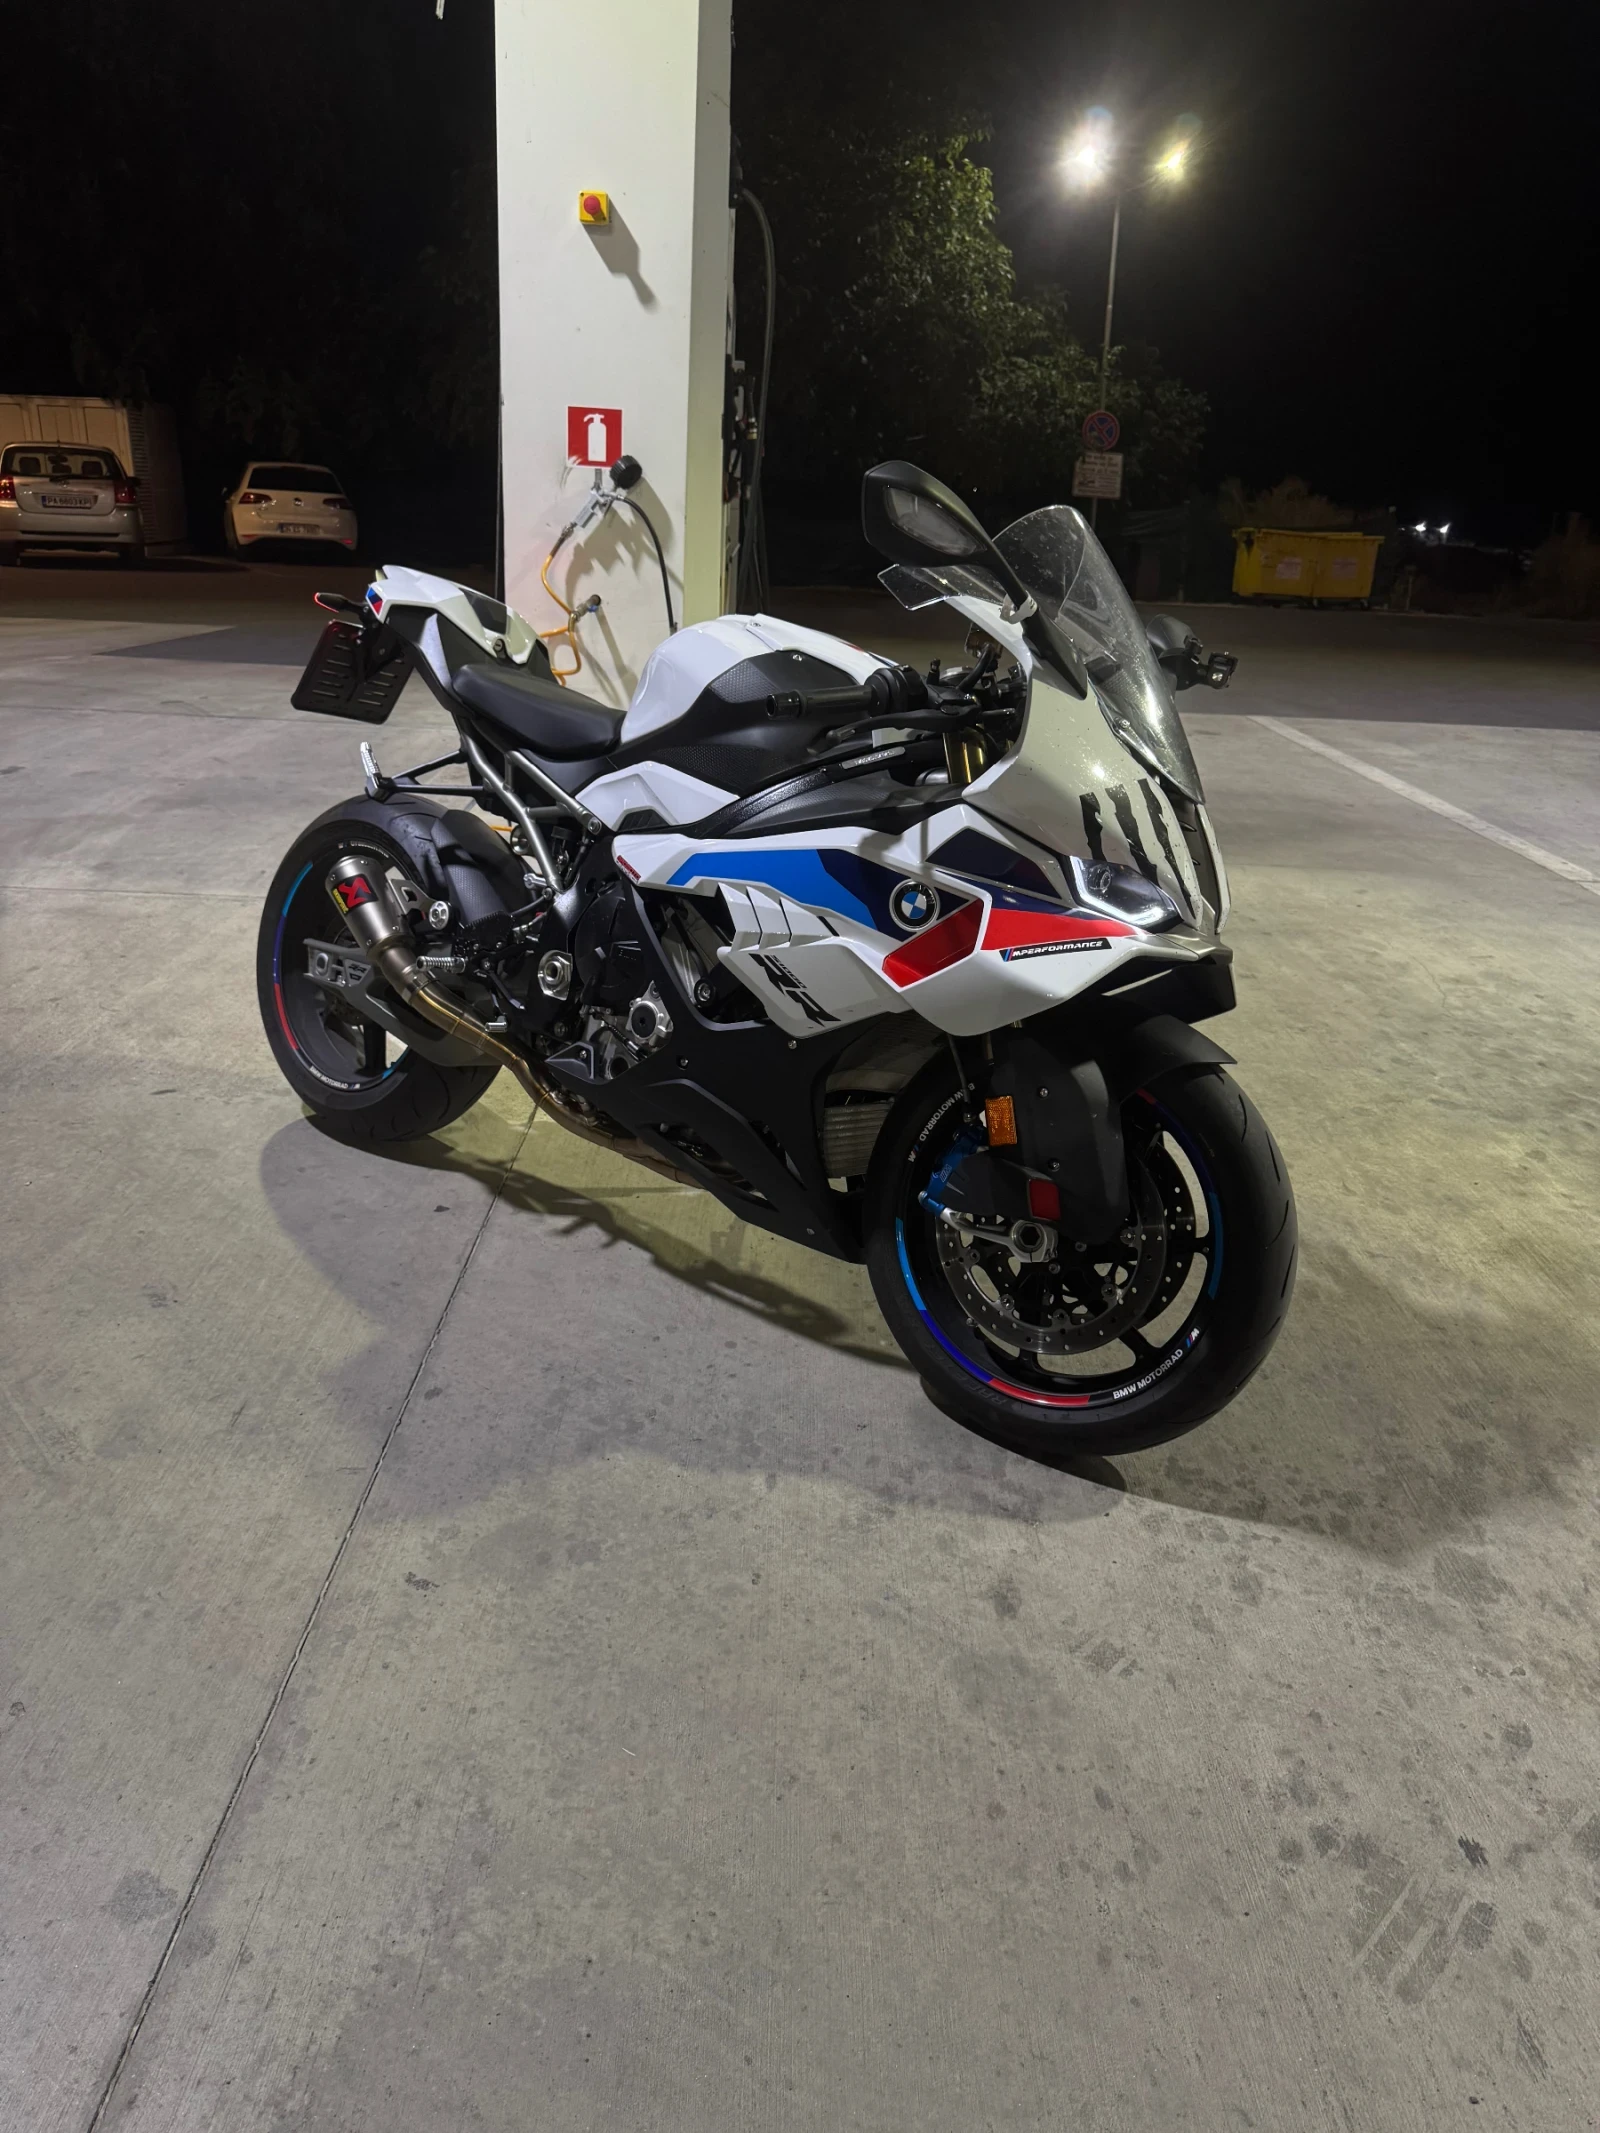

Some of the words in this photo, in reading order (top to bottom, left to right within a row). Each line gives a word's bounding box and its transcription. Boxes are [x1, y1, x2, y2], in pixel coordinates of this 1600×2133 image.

[919, 1097, 956, 1141] MOTORRAD
[1112, 1383, 1137, 1400] BMW
[1136, 1348, 1184, 1390] MOTORRAD
